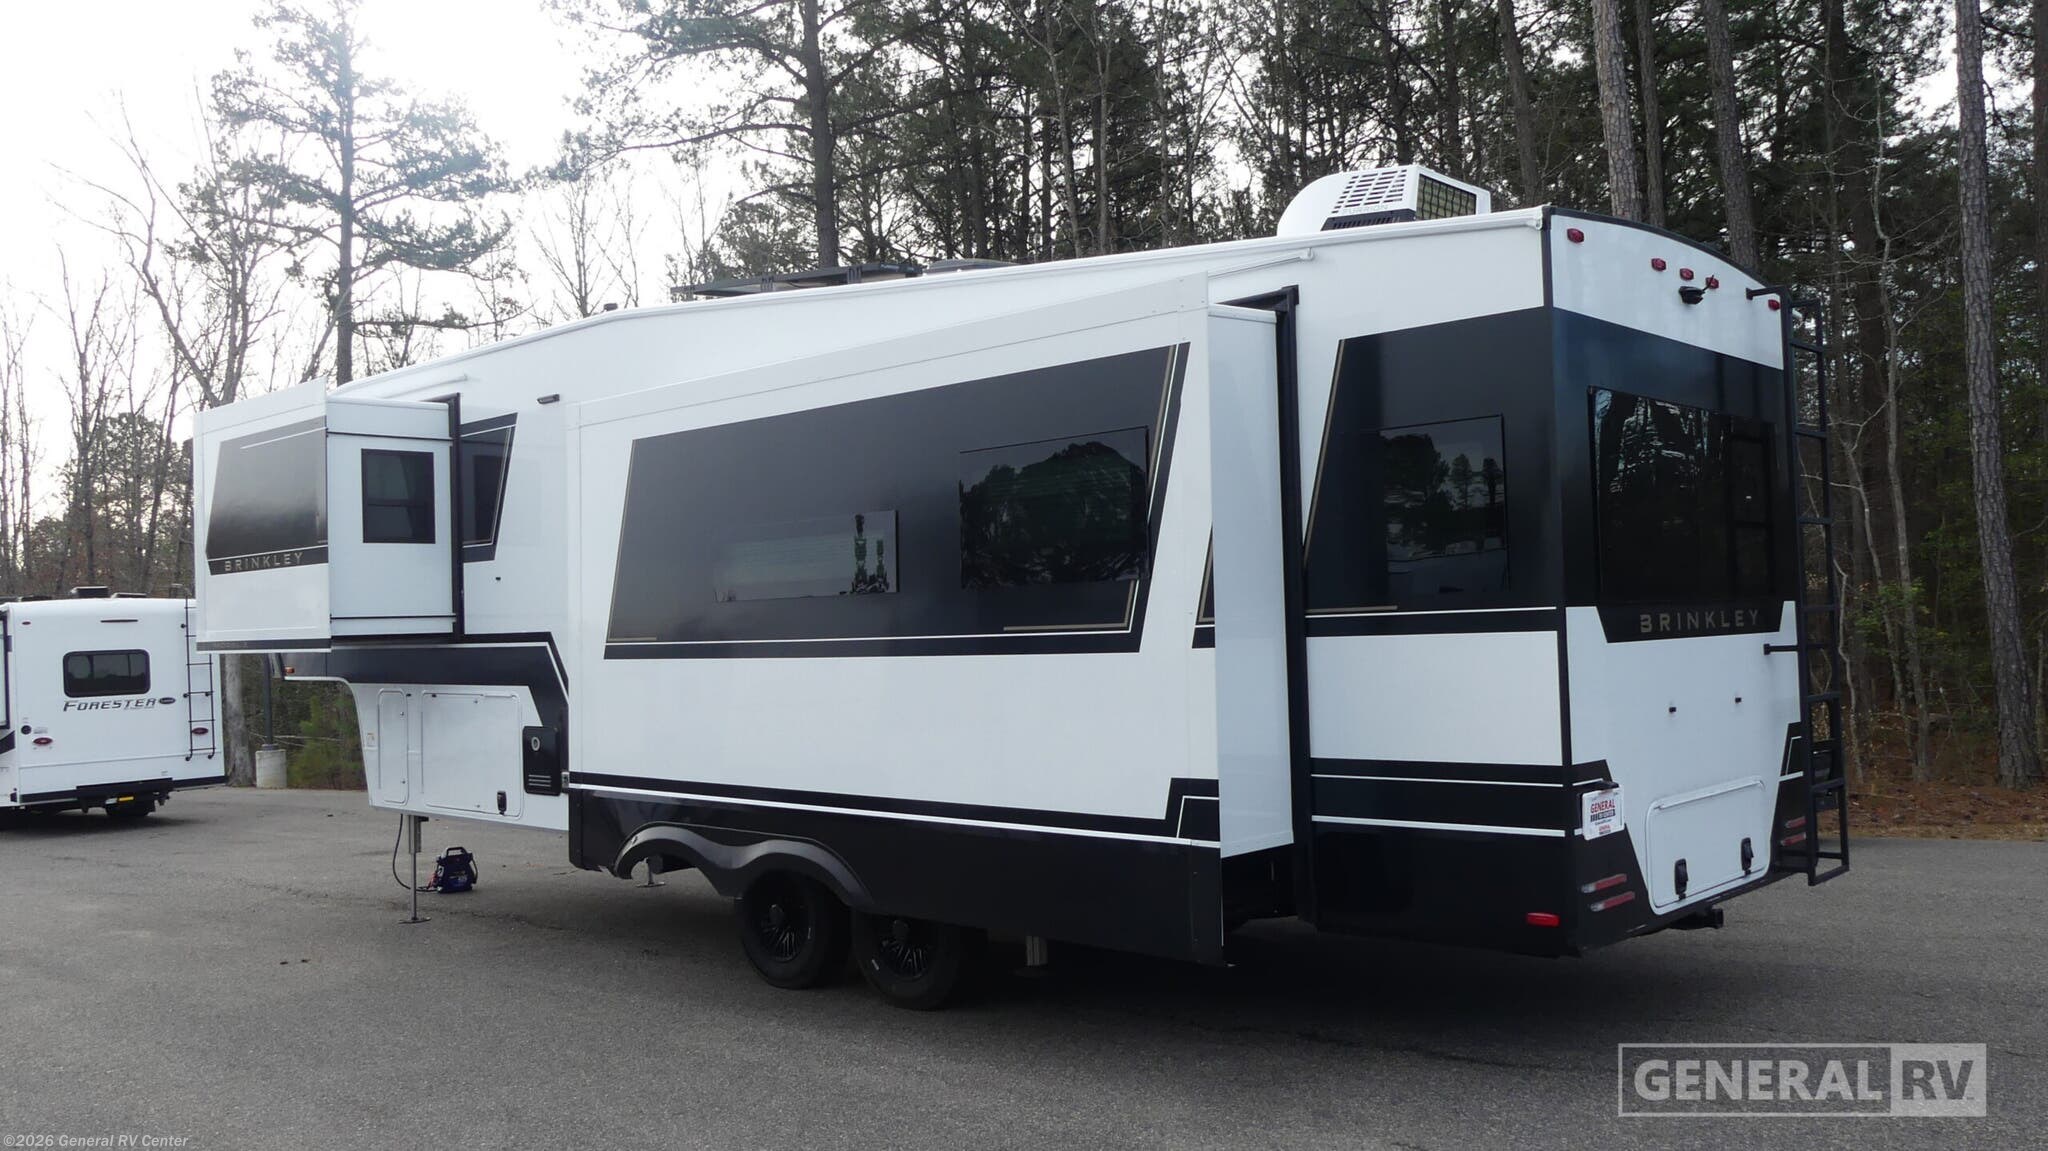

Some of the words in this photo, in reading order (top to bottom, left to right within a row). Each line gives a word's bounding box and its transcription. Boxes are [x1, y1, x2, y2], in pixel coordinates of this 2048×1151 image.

[224, 552, 303, 572] BRINKLEY
[1639, 608, 1759, 633] BRINKLEY
[1590, 799, 1616, 814] GENERAL
